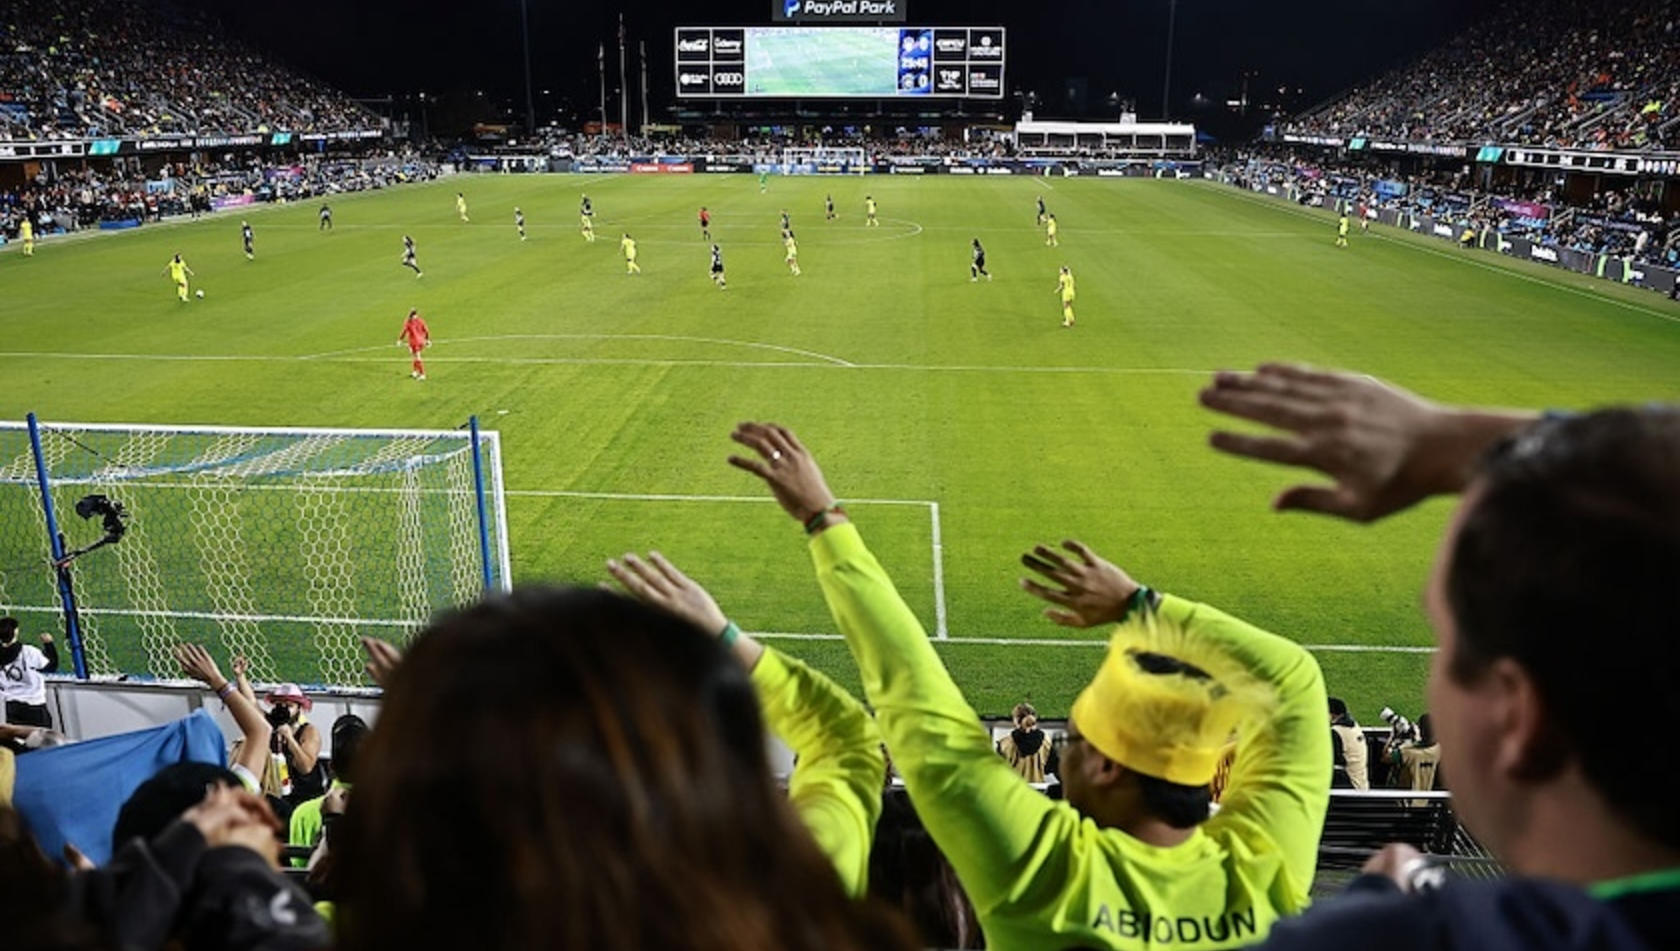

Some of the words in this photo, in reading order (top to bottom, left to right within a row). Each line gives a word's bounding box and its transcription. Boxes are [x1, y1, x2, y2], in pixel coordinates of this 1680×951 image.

[804, 0, 857, 16] PayPal
[860, 1, 895, 14] Park
[1093, 904, 1256, 943] ABIODUN
